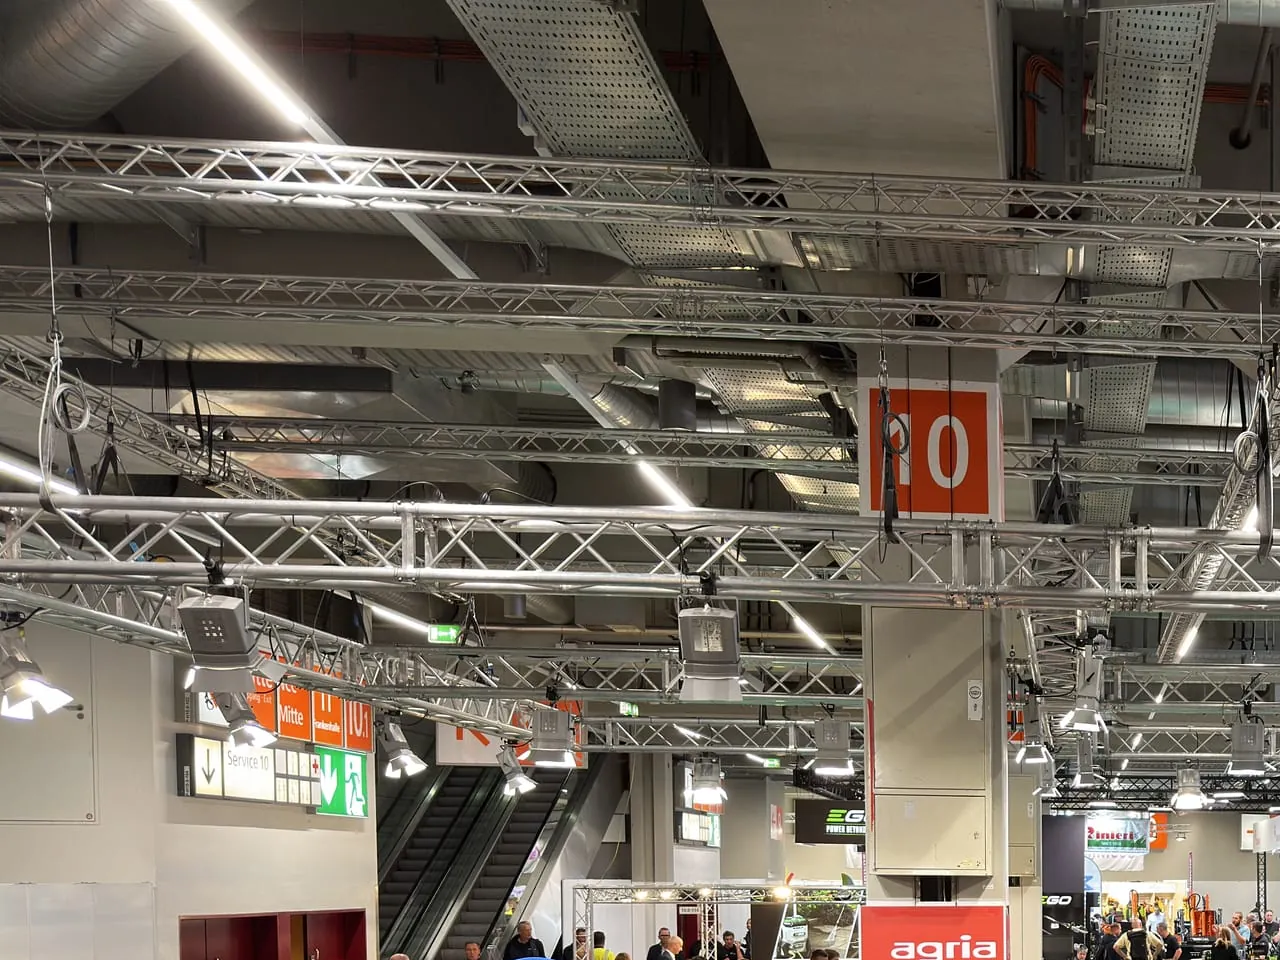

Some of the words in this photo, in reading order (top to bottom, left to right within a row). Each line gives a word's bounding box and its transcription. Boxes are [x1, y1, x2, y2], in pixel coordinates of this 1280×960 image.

[889, 413, 969, 489] 10
[279, 704, 304, 727] Mitte
[227, 750, 259, 769] Service
[260, 755, 269, 771] 10
[826, 809, 866, 823] EG
